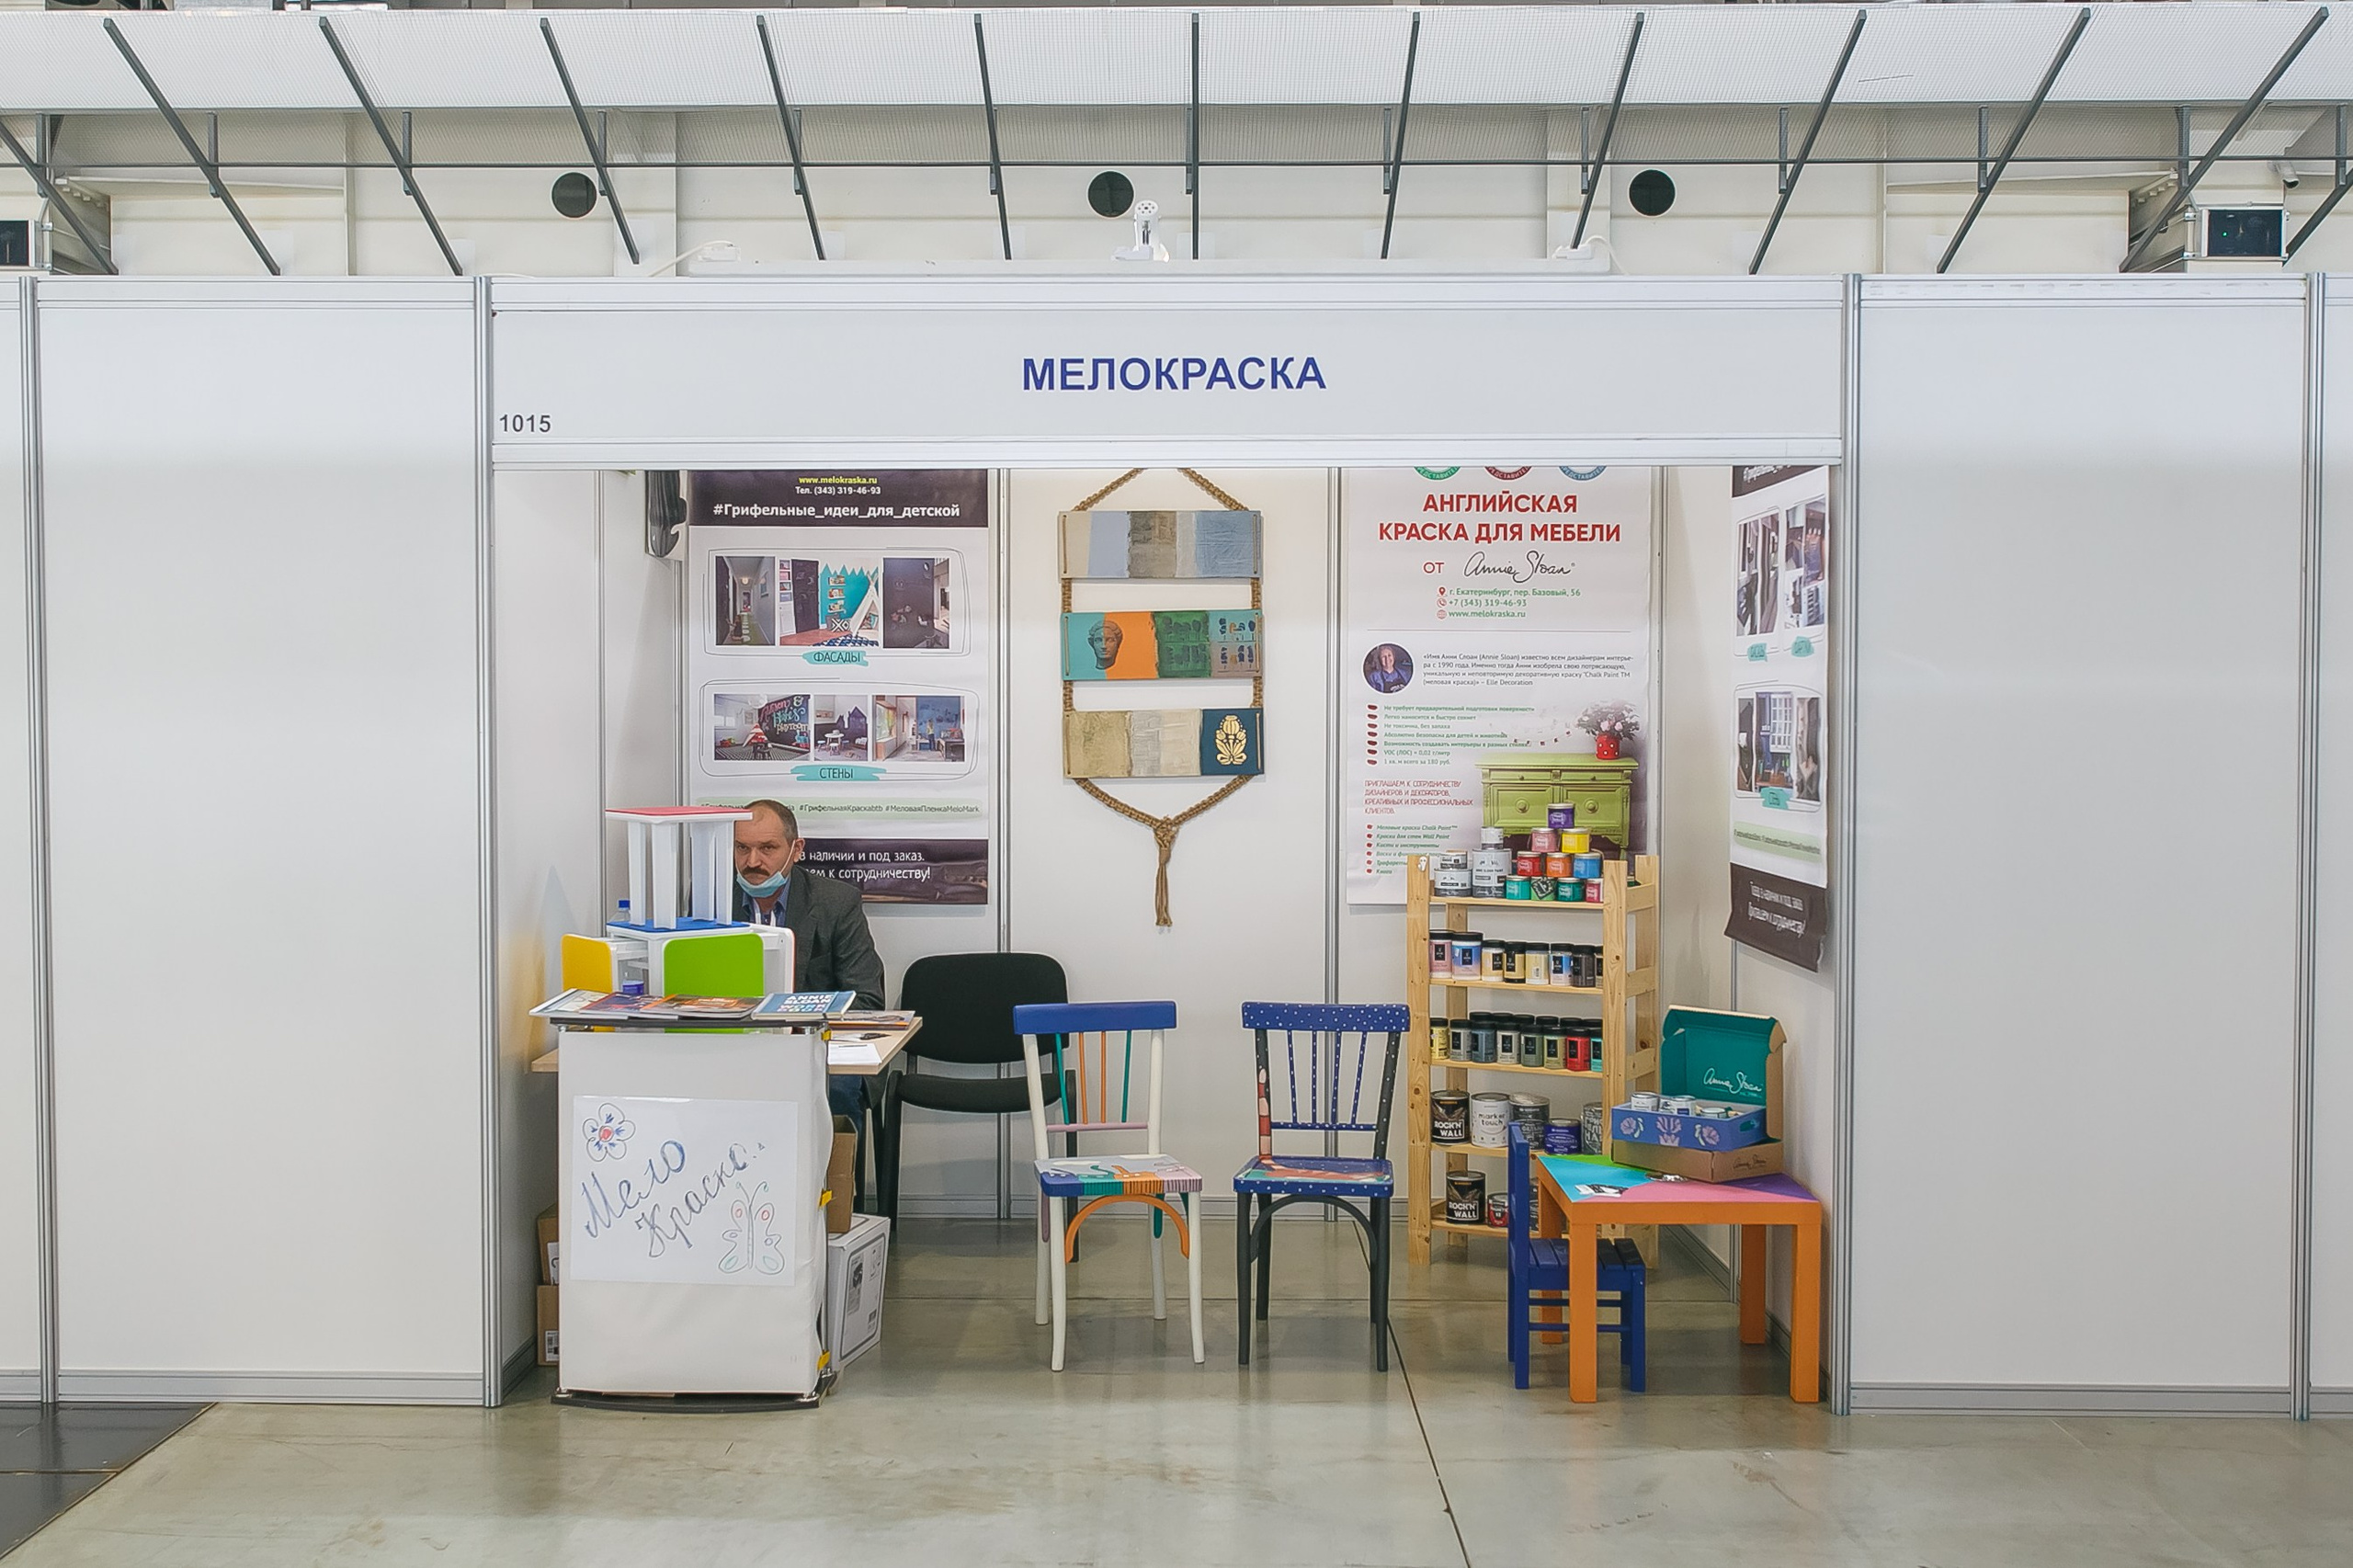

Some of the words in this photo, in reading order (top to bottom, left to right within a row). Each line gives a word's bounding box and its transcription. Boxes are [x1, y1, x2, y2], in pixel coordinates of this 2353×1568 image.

[1023, 357, 1327, 391] МЕЛОКРАСКА
[499, 414, 551, 433] 1015
[798, 475, 878, 484] www.melokraska.ru
[795, 486, 813, 494] Тел.
[813, 486, 836, 495] (343)
[837, 486, 881, 494] 319-46-93
[1422, 490, 1578, 514] АНГЛИЙСКАЯ
[713, 503, 961, 518] #Грифельные_идеи_для_детской
[1379, 522, 1469, 541] КРАСКА
[1474, 523, 1523, 544] ДЛЯ
[1530, 523, 1621, 542] МЕБЕЛИ
[1423, 562, 1445, 574] ОТ
[1463, 551, 1516, 577] Annie
[1456, 588, 1512, 597] Екатеринбург,
[1513, 589, 1531, 597] пер.
[1531, 588, 1569, 597] Базовый,
[1449, 598, 1459, 607] +7
[1460, 598, 1483, 608] (343)
[1484, 598, 1528, 607] 319-46-93
[1448, 609, 1527, 618] www.melokraska.ru
[813, 651, 861, 665] ФАСАДЫ
[819, 767, 855, 780] СТЕНЫ
[809, 851, 856, 862] наличии
[858, 852, 866, 861] и
[869, 852, 892, 863] под
[893, 851, 926, 862] заказ.
[828, 869, 835, 879] к
[838, 867, 932, 882] сотрудничеству!
[580, 1140, 686, 1239] Мело
[1454, 1210, 1477, 1219] WALL
